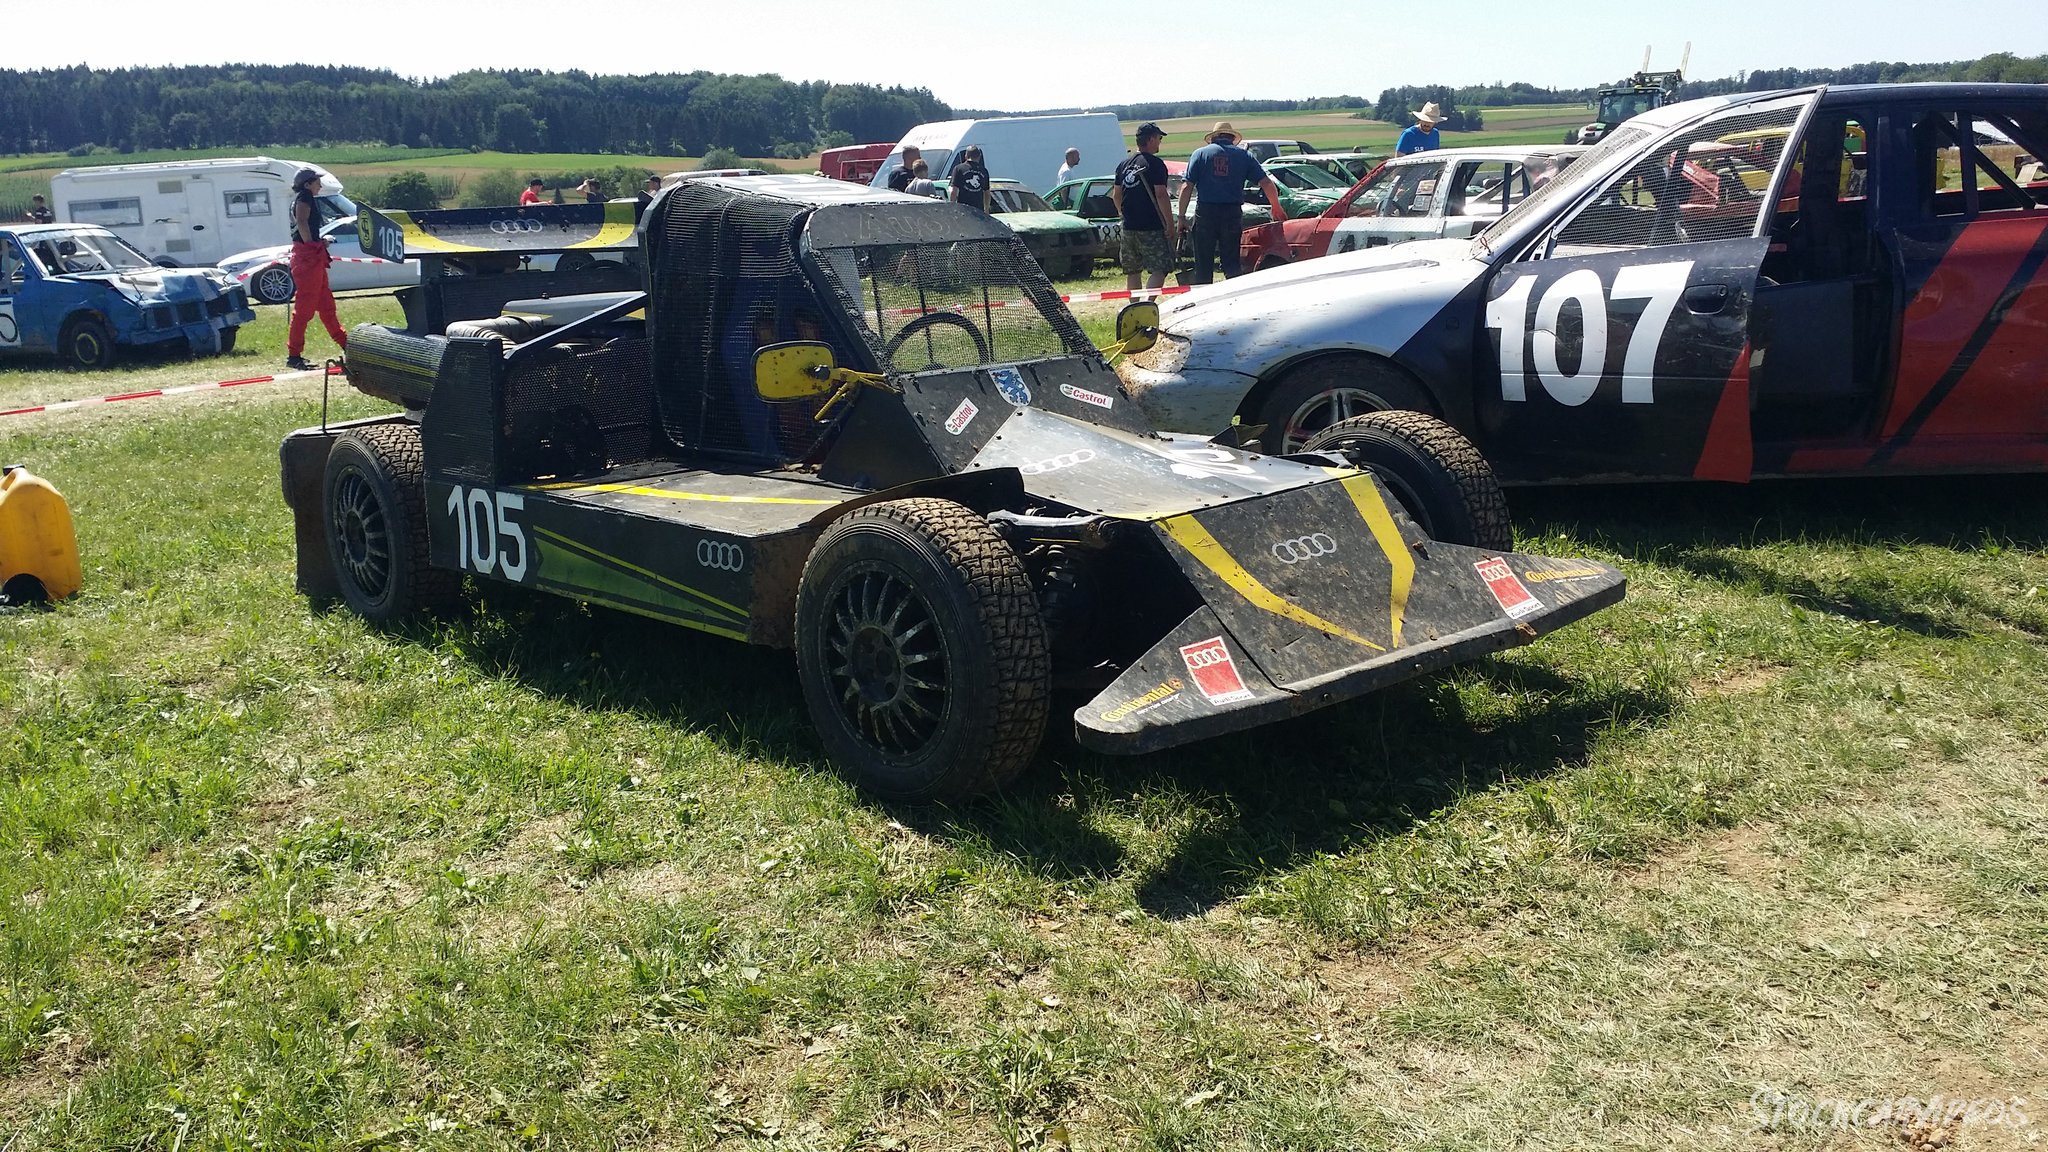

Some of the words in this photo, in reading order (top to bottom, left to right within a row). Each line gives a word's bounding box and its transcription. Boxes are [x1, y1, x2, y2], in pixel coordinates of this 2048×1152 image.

[379, 226, 403, 260] 105
[1485, 261, 1695, 406] 107
[1073, 389, 1108, 406] Castrol
[953, 404, 975, 429] Castrol
[447, 484, 527, 583] 105
[1100, 682, 1176, 722] Continental
